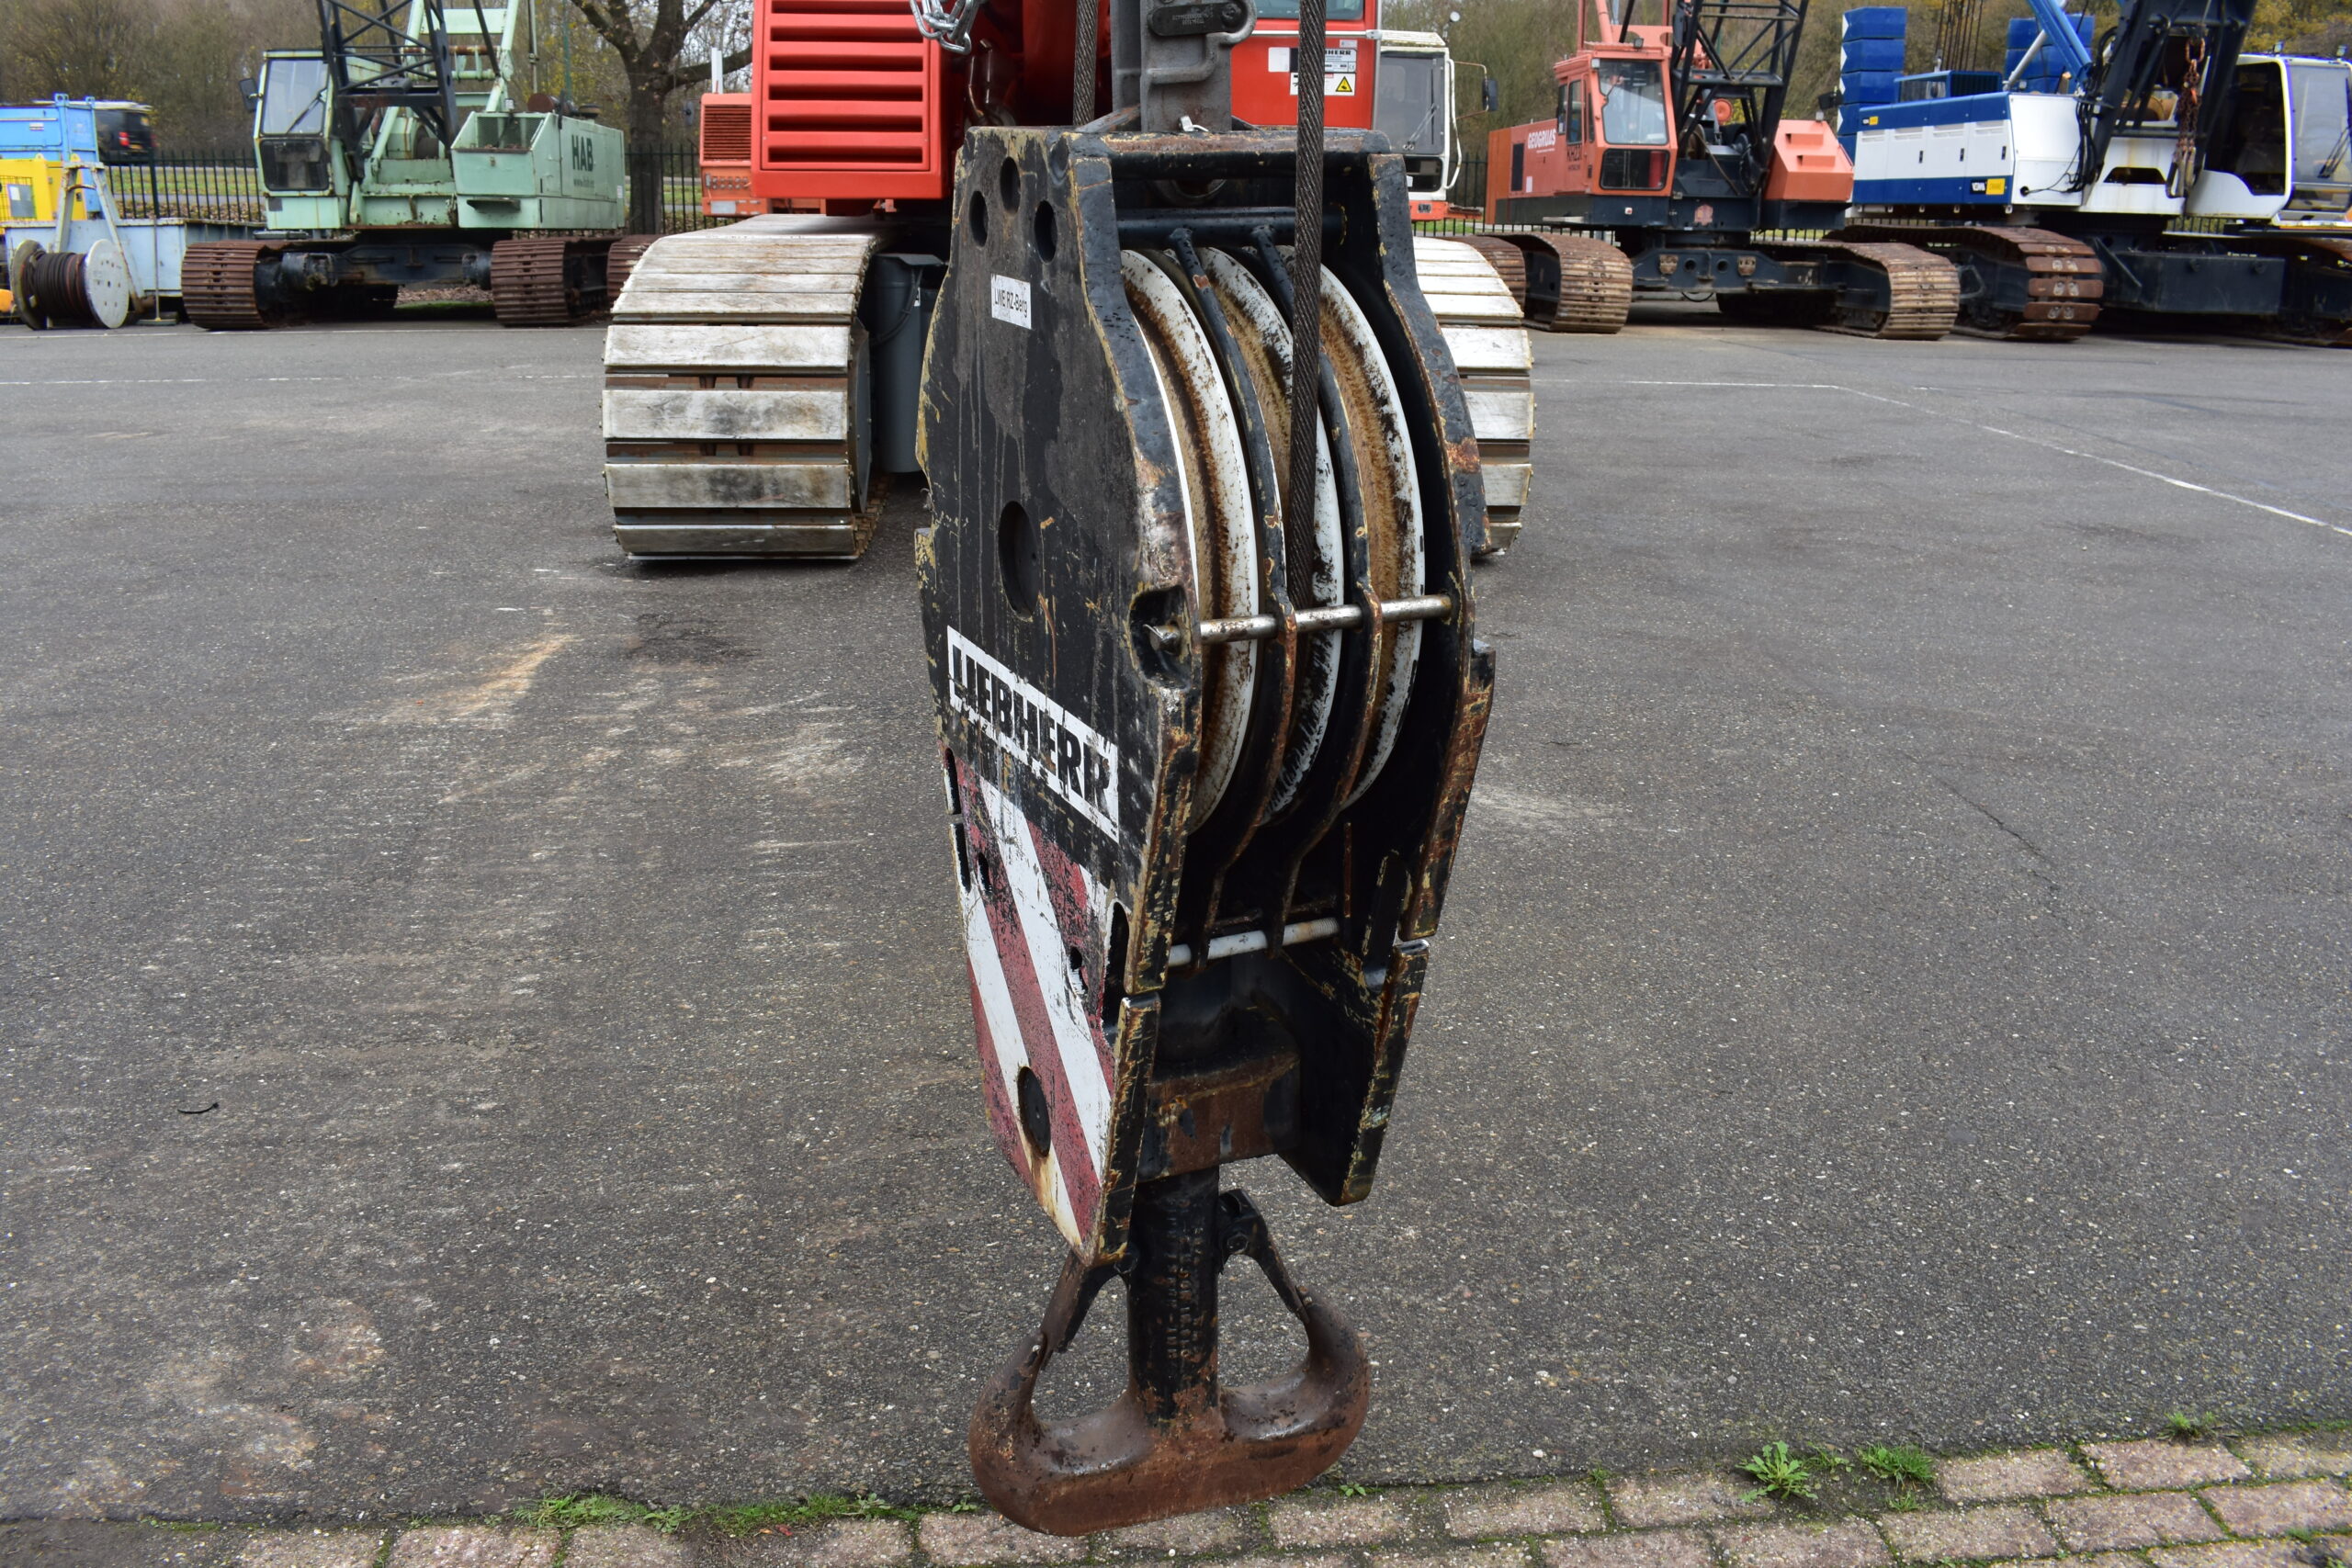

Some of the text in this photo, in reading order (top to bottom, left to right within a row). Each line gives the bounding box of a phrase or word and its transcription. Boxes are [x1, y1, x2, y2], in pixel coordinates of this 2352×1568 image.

[571, 134, 594, 172] HAB
[1528, 129, 1556, 149] GEOGRUAS
[952, 643, 1117, 823] LIEBHERR
